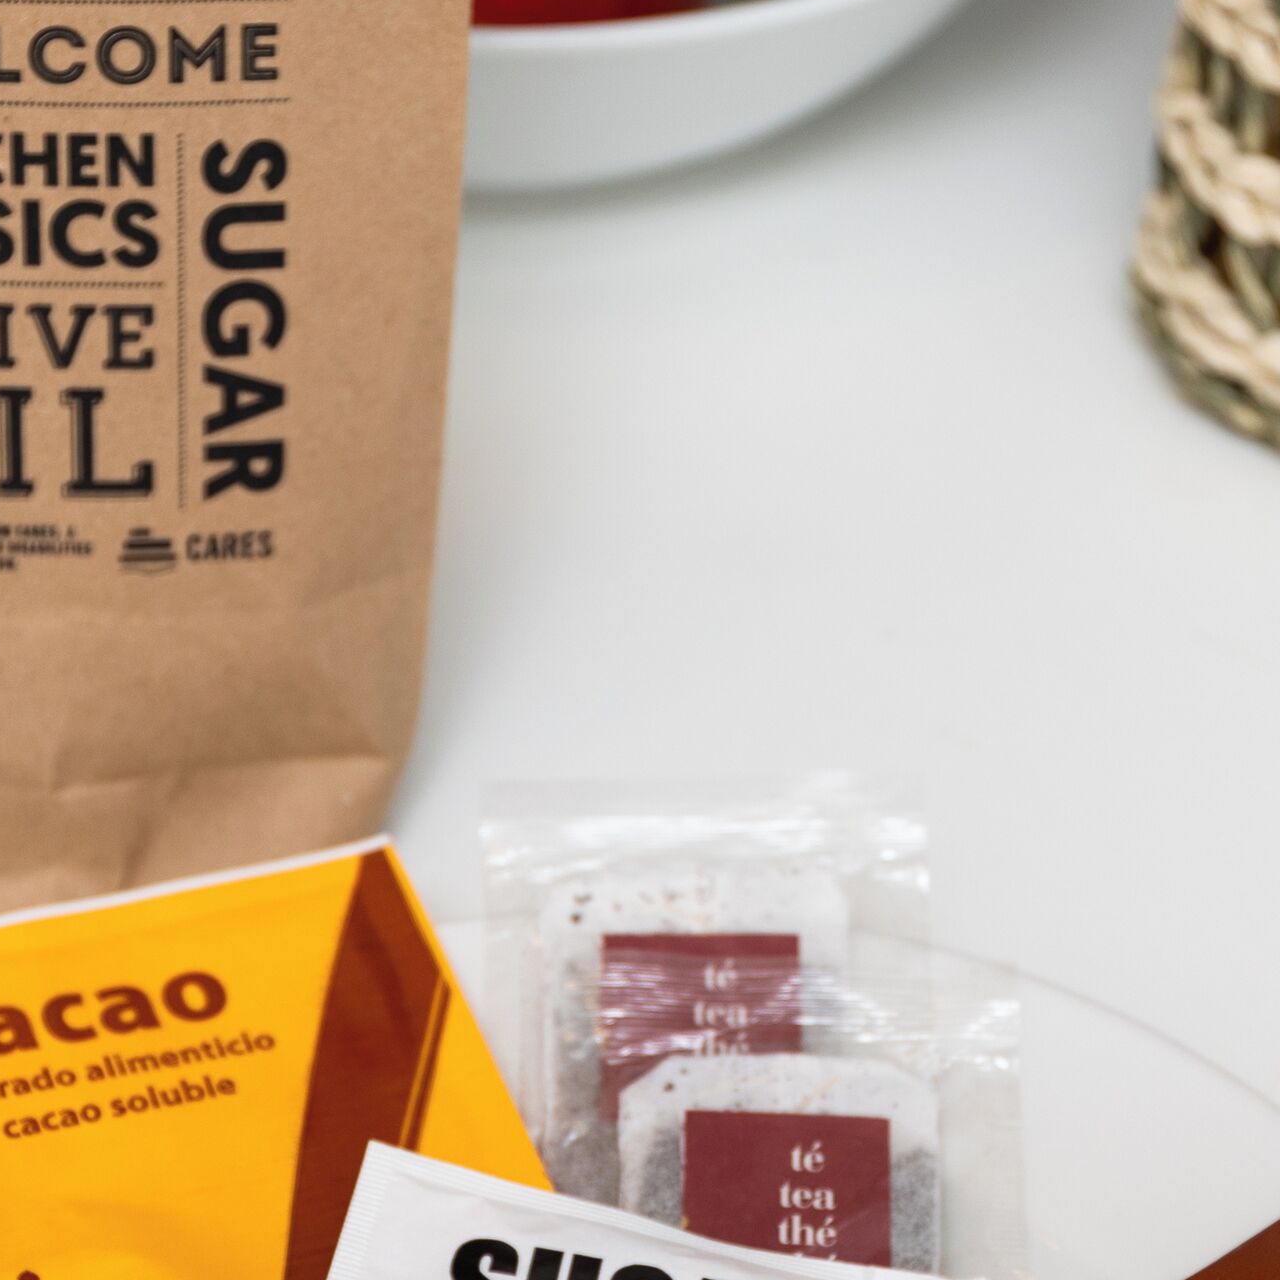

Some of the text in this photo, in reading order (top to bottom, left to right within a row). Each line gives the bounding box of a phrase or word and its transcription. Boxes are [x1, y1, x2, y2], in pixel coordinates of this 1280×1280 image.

[200, 139, 287, 500] SUGAR
[186, 530, 273, 560] CARES
[86, 1030, 276, 1083] alimenticio
[3, 1101, 101, 1140] cacao
[110, 1073, 237, 1119] soluble
[790, 1142, 824, 1173] té
[779, 1181, 835, 1211] tea
[777, 1214, 837, 1248] thé
